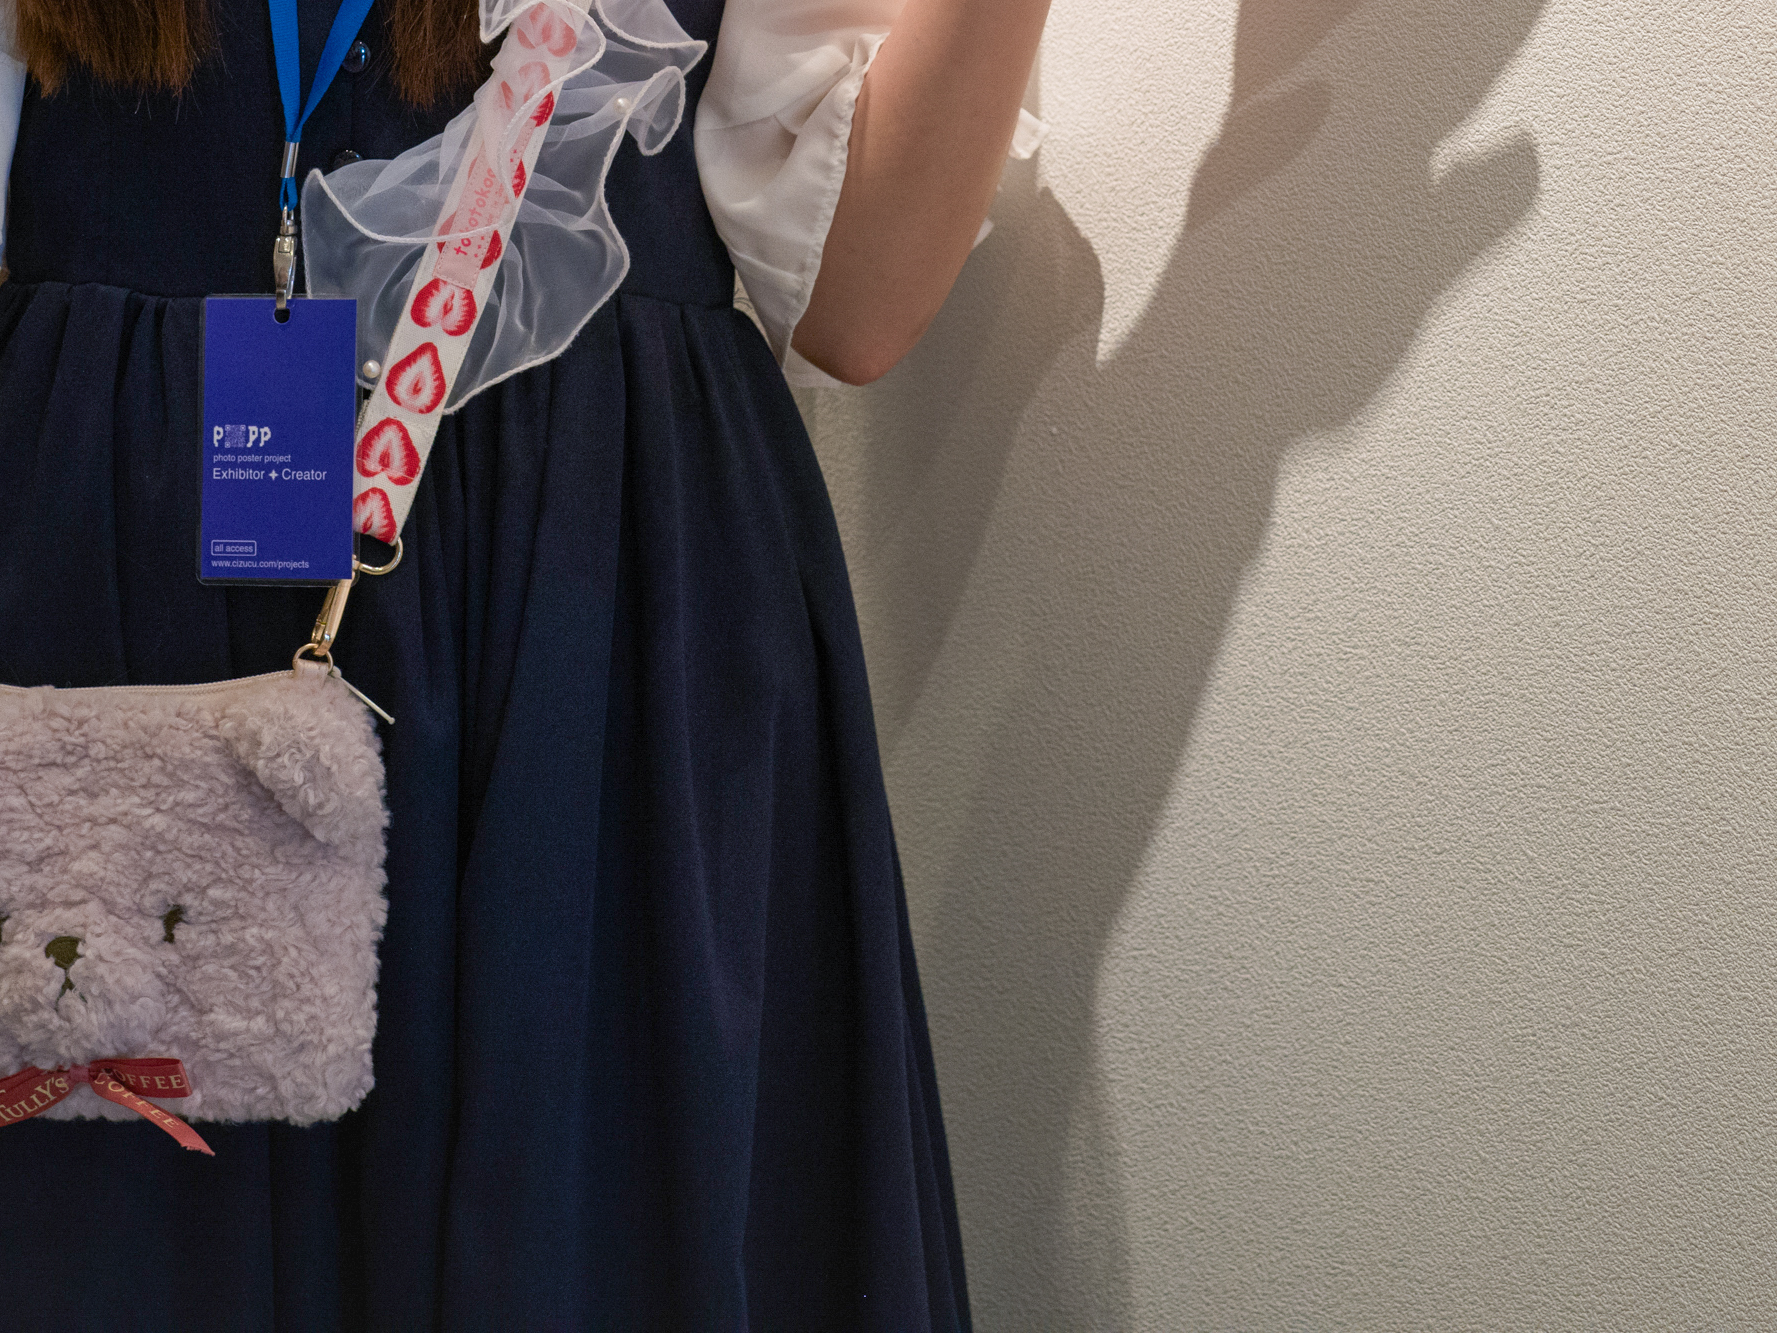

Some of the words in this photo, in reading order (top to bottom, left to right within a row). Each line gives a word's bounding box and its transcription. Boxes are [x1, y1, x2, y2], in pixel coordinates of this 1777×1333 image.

[213, 453, 236, 464] photo
[237, 453, 263, 464] poster
[264, 453, 291, 465] project
[212, 467, 265, 480] Exhibitor
[281, 468, 327, 481] Creator
[214, 544, 224, 552] all
[225, 545, 254, 553] access
[211, 559, 310, 571] www.cizucu.com/projects
[115, 1069, 187, 1090] OFFEE
